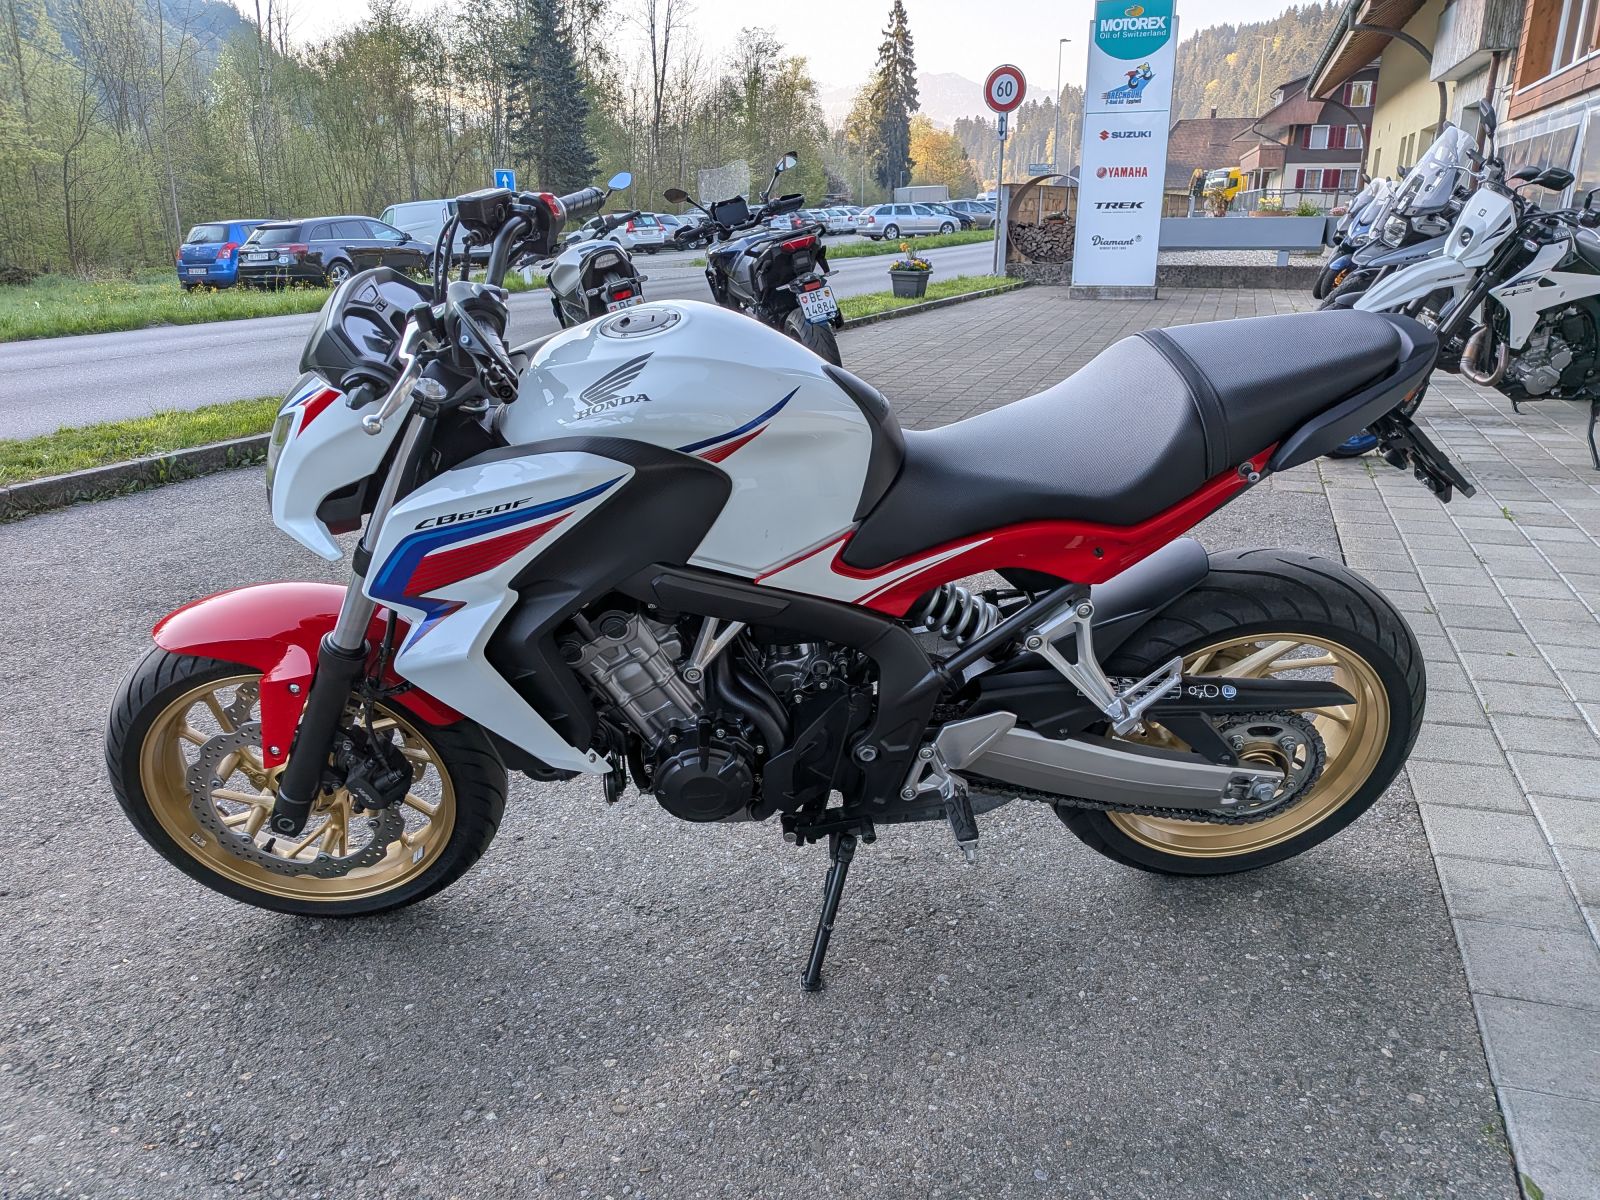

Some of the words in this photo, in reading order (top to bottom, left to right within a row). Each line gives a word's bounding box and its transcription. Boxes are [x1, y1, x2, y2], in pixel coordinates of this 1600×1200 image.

[1100, 16, 1167, 32] MOTOREX
[1122, 29, 1167, 38] Switzerland
[996, 80, 1013, 97] 60
[1108, 166, 1148, 177] YAMAHA
[1094, 201, 1145, 209] TREK
[1091, 234, 1134, 246] Diamant
[809, 290, 823, 303] BE
[805, 300, 835, 317] 14884
[576, 393, 653, 420] HONDA
[414, 496, 534, 530] CB650F
